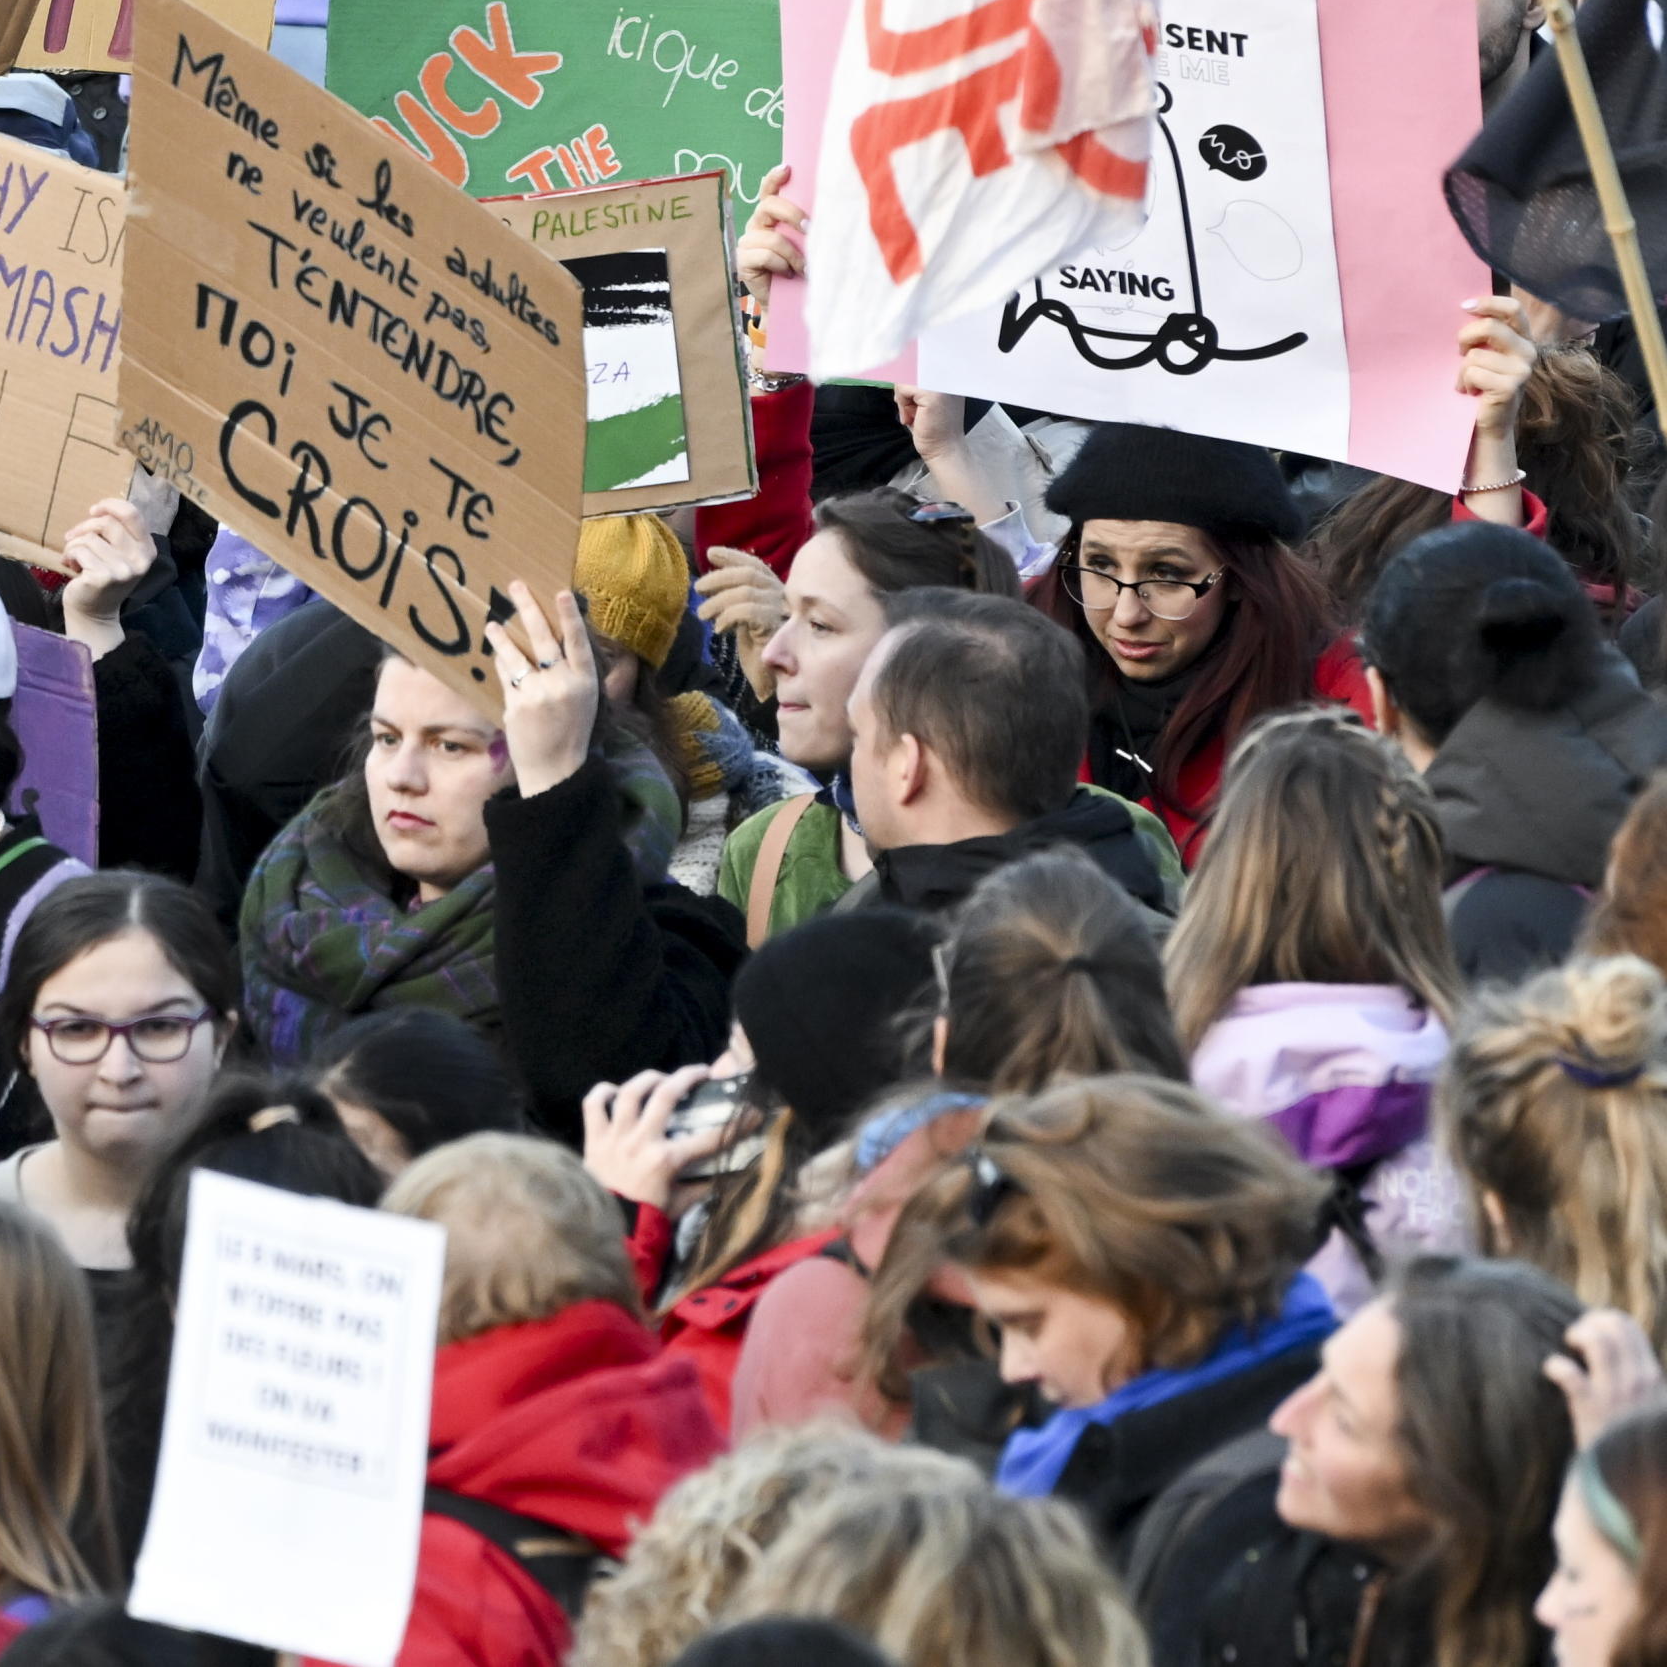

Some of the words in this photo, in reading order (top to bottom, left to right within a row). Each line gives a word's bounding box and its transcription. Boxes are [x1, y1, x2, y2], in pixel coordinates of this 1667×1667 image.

[367, 1, 563, 192] UCK
[506, 122, 622, 194] THE
[170, 31, 281, 152] Même
[305, 140, 343, 191] si
[356, 159, 417, 240] les
[444, 247, 563, 349] adultes
[225, 148, 267, 198] ne
[290, 189, 419, 300] veulent
[429, 289, 495, 356] pas,
[1058, 264, 1176, 303] SAYING
[327, 379, 393, 472] JE
[427, 455, 497, 541] TE
